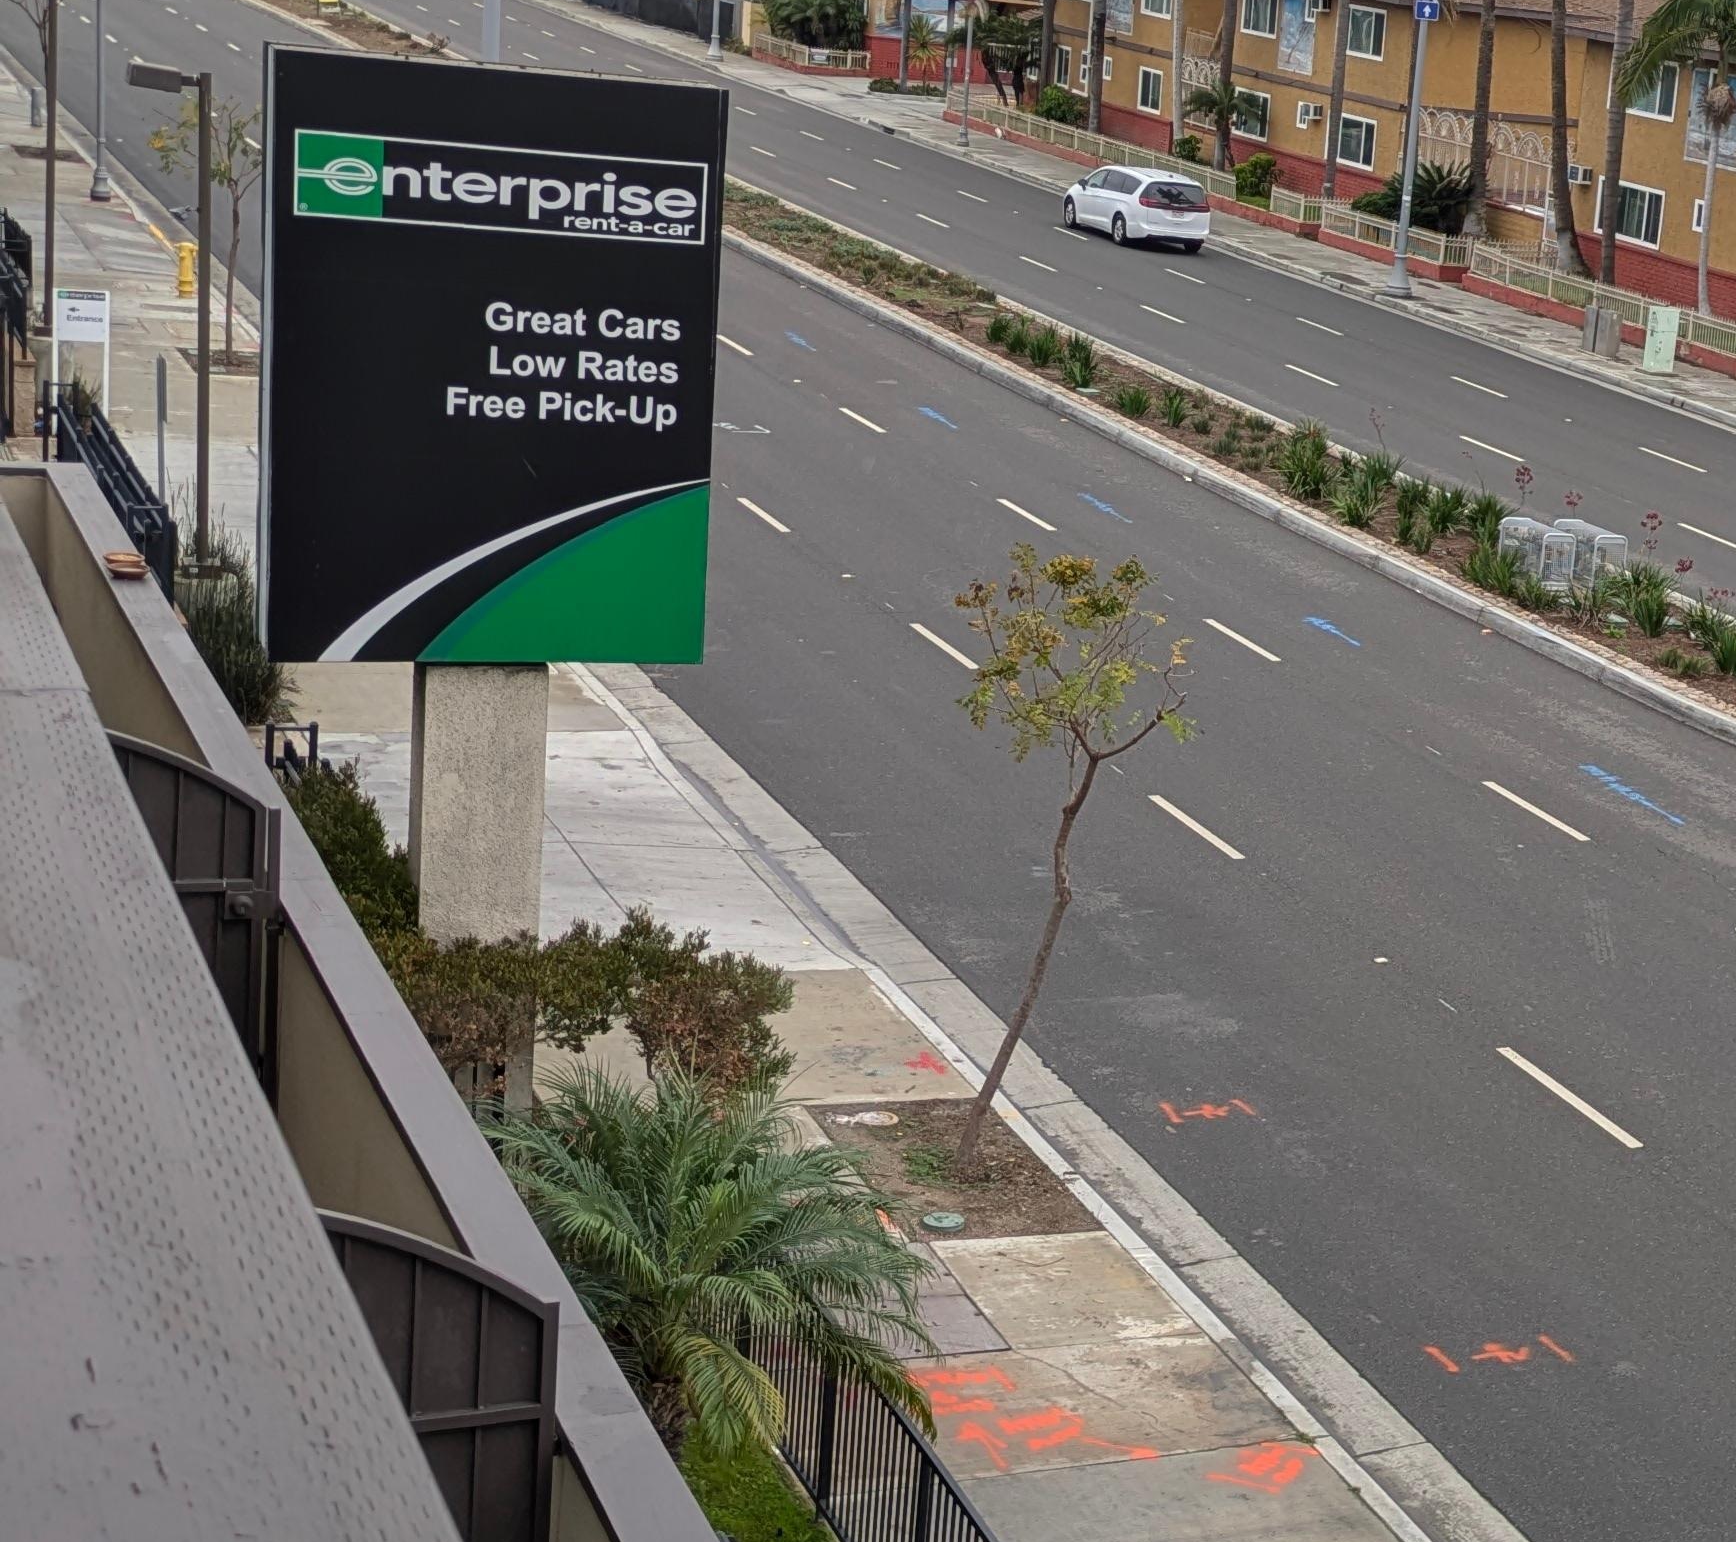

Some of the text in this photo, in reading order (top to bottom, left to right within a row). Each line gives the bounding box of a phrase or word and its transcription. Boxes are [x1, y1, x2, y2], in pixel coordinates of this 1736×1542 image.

[322, 157, 698, 219] enterprise
[563, 213, 695, 236] rent-a-car
[66, 314, 104, 323] Entrance
[485, 302, 681, 341] Great Cars
[489, 346, 679, 384] Low Rates
[446, 386, 678, 432] Free Pick-Up
